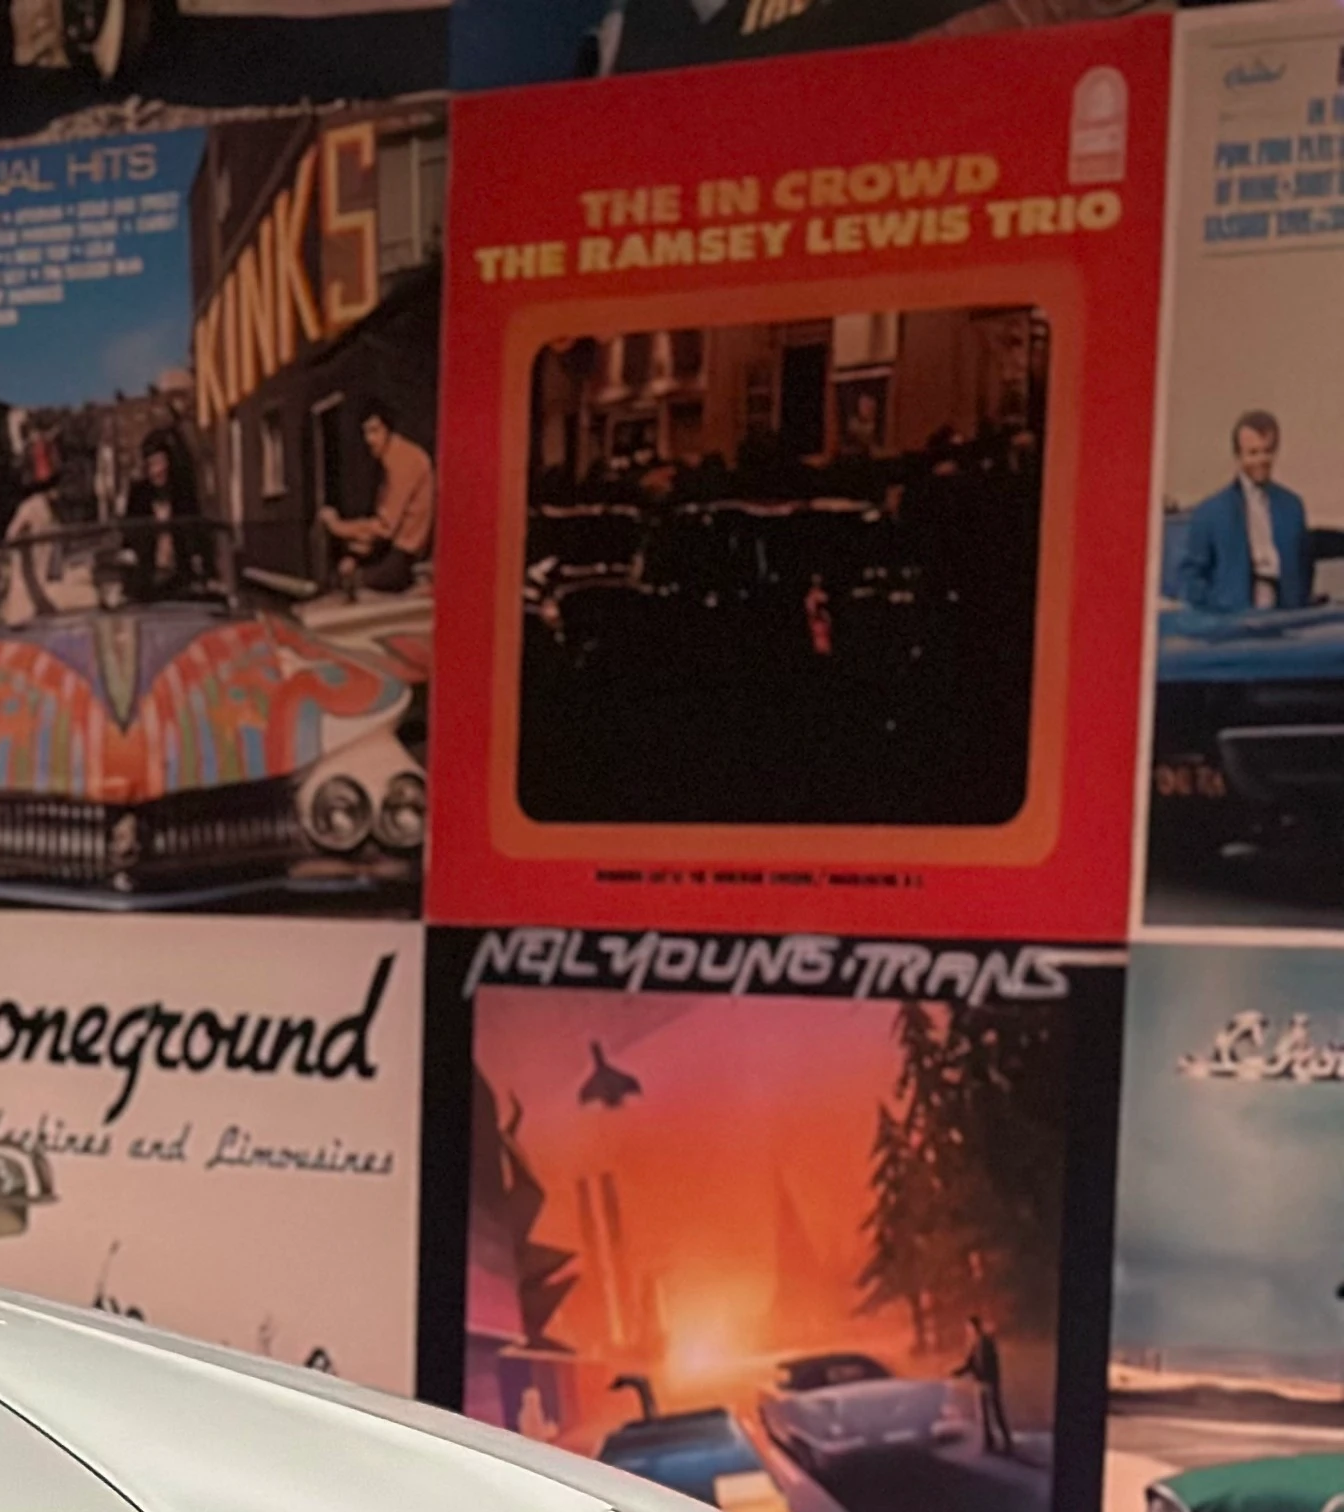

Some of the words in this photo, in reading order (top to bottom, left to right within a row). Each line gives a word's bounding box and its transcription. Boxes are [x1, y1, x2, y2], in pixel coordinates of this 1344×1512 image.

[67, 143, 158, 188] HITS
[581, 185, 681, 230] THE
[698, 176, 760, 219] IN
[772, 153, 999, 211] CROWD
[195, 120, 378, 429] KINKS
[475, 241, 566, 283] THE
[578, 220, 792, 275] RAMSEY
[806, 205, 971, 255] LEWIS
[985, 190, 1123, 240] TRIO
[599, 930, 839, 996] YOUNG
[842, 943, 1077, 1007] TRANS
[128, 1121, 193, 1162] and
[205, 1124, 394, 1175] Limousines
